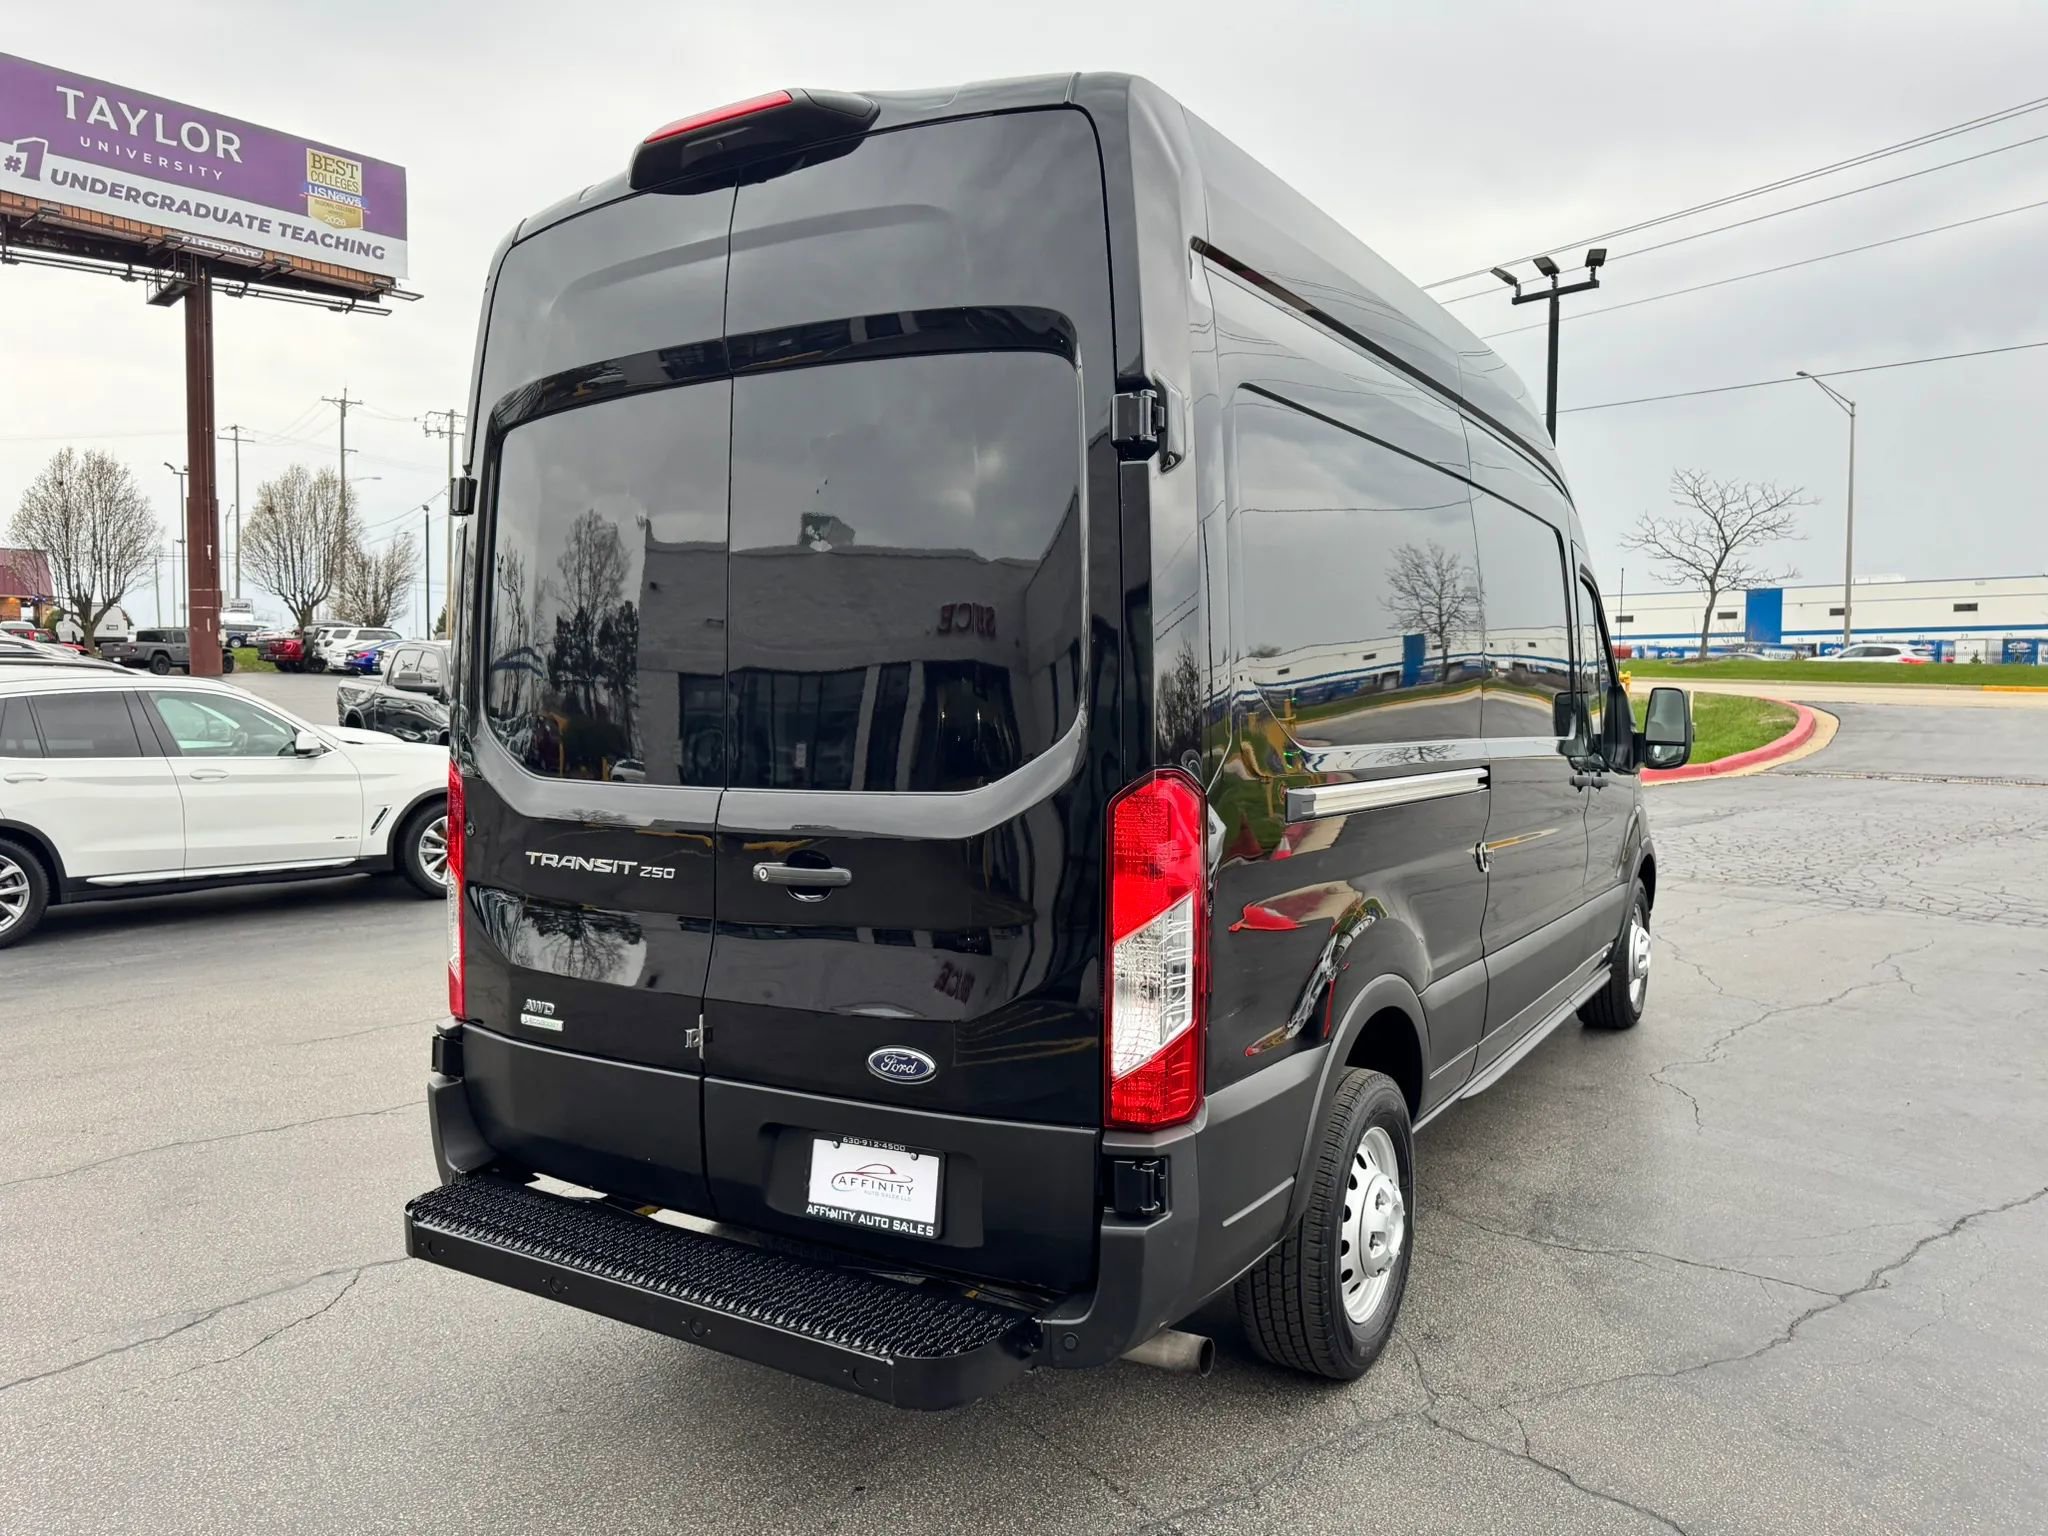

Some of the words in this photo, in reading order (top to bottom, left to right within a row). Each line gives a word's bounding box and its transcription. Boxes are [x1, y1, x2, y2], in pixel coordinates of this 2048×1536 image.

[55, 84, 243, 164] TAYLOR
[79, 136, 225, 181] UNIVERSITY
[310, 152, 358, 179] BEST
[310, 170, 359, 193] COLLEGES
[4, 138, 47, 181] #1
[50, 167, 271, 234] UNDERGRADUATE
[278, 222, 386, 262] TEACHING
[525, 851, 638, 875] TRANSIT
[639, 866, 676, 879] 250
[523, 998, 555, 1015] AWD
[880, 1054, 918, 1074] Ford
[838, 1176, 914, 1195] AFFINITY
[806, 1204, 857, 1223] AFFINITY
[858, 1213, 889, 1229] AUTO
[892, 1220, 934, 1237] SALES
